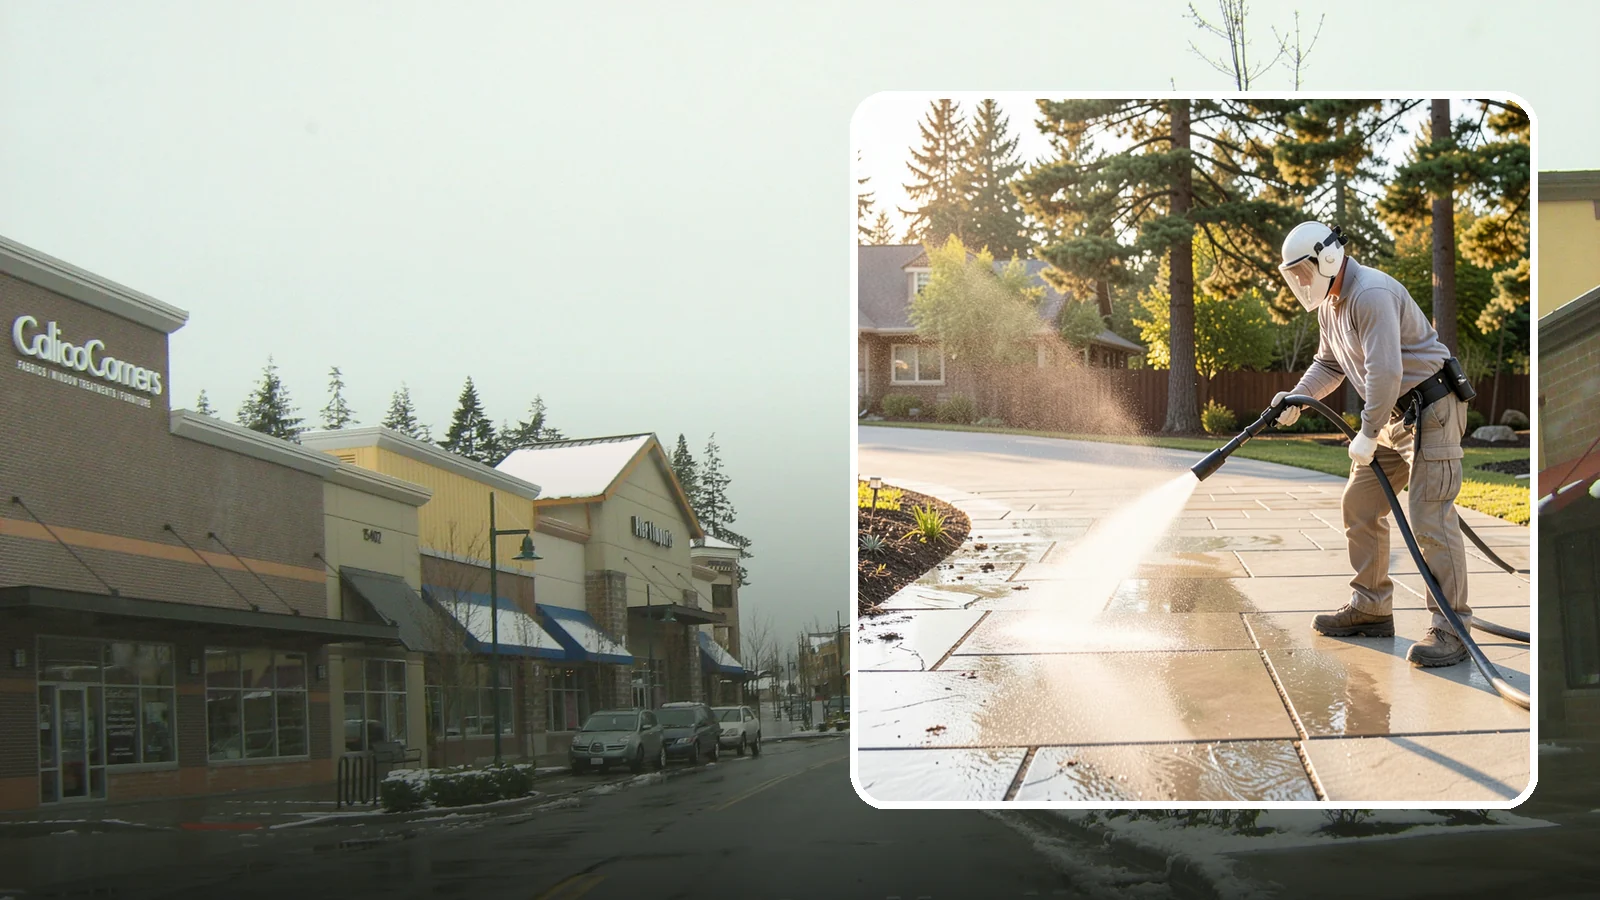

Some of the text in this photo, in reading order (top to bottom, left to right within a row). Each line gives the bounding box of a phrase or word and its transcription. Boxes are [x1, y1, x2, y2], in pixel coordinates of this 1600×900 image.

[16, 360, 47, 377] FABRICS
[51, 370, 78, 386] WINDOW
[79, 379, 116, 398] TREATMENTS
